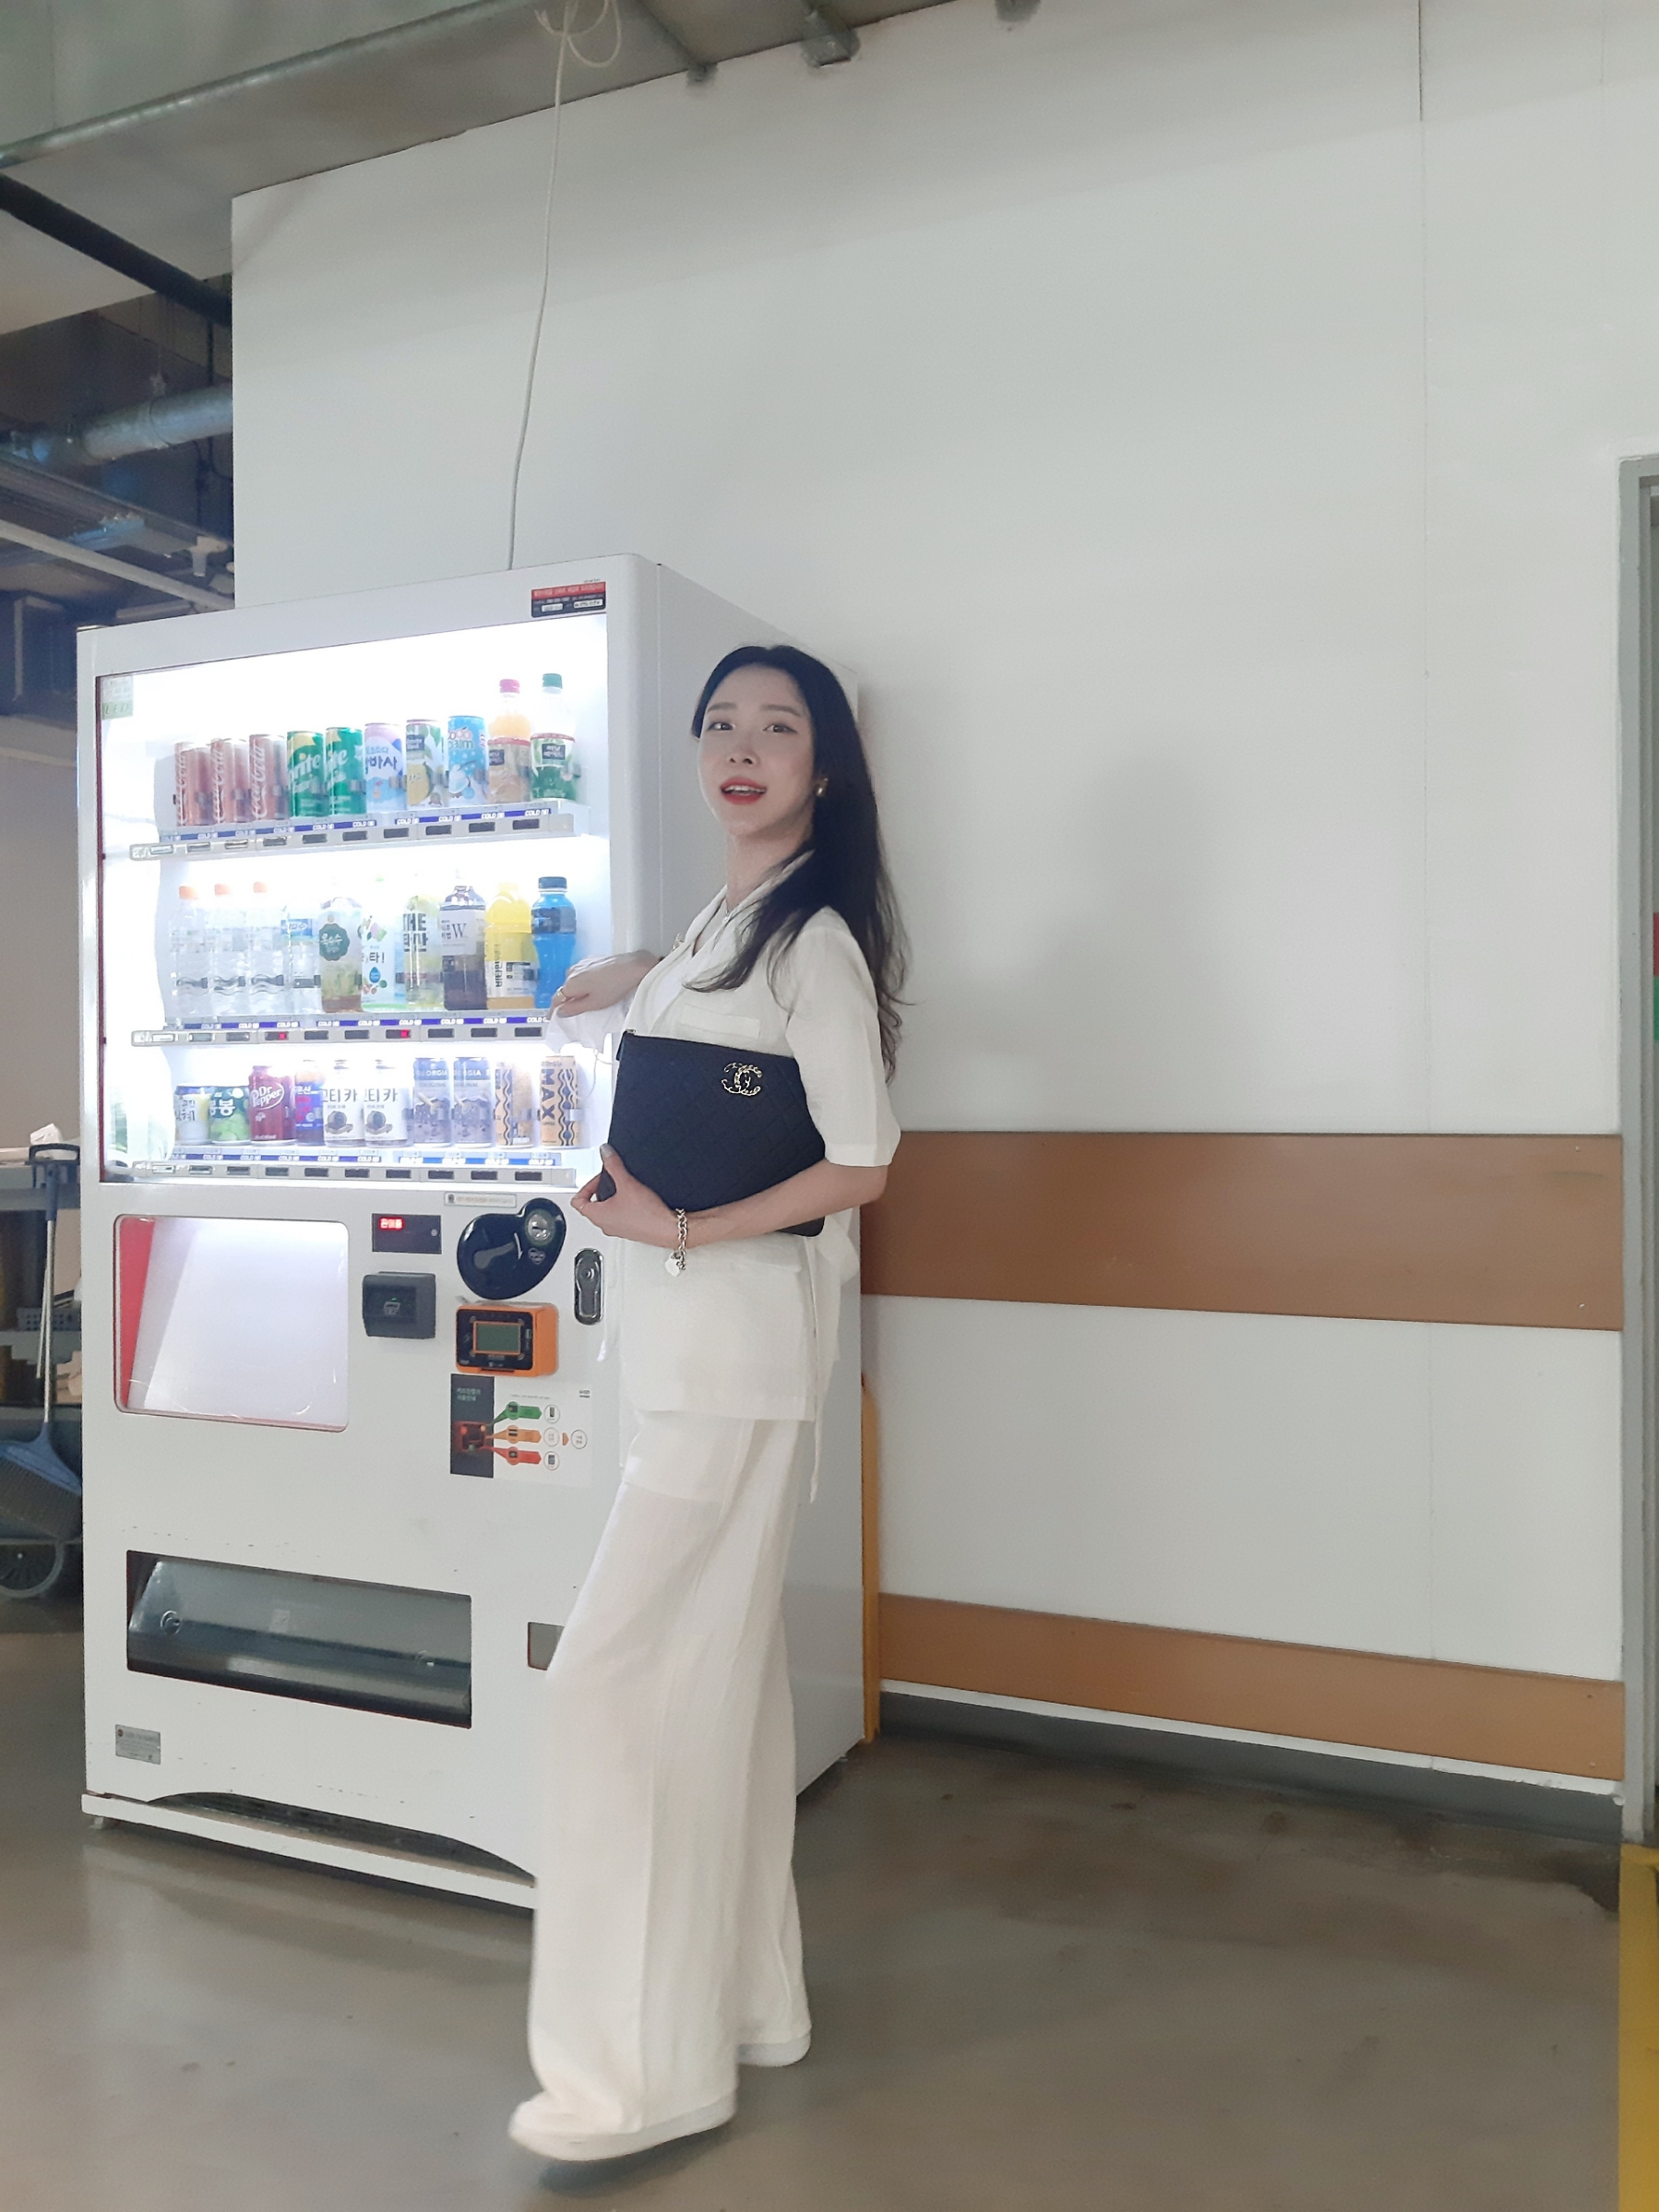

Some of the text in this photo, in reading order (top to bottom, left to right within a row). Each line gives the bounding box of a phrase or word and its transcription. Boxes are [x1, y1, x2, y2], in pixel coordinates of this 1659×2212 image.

[403, 913, 427, 931] THE
[452, 923, 467, 939] W
[250, 1088, 282, 1108] Pepper
[258, 1086, 273, 1097] Dr
[364, 1088, 399, 1103] 티카
[541, 1068, 555, 1120] MAX
